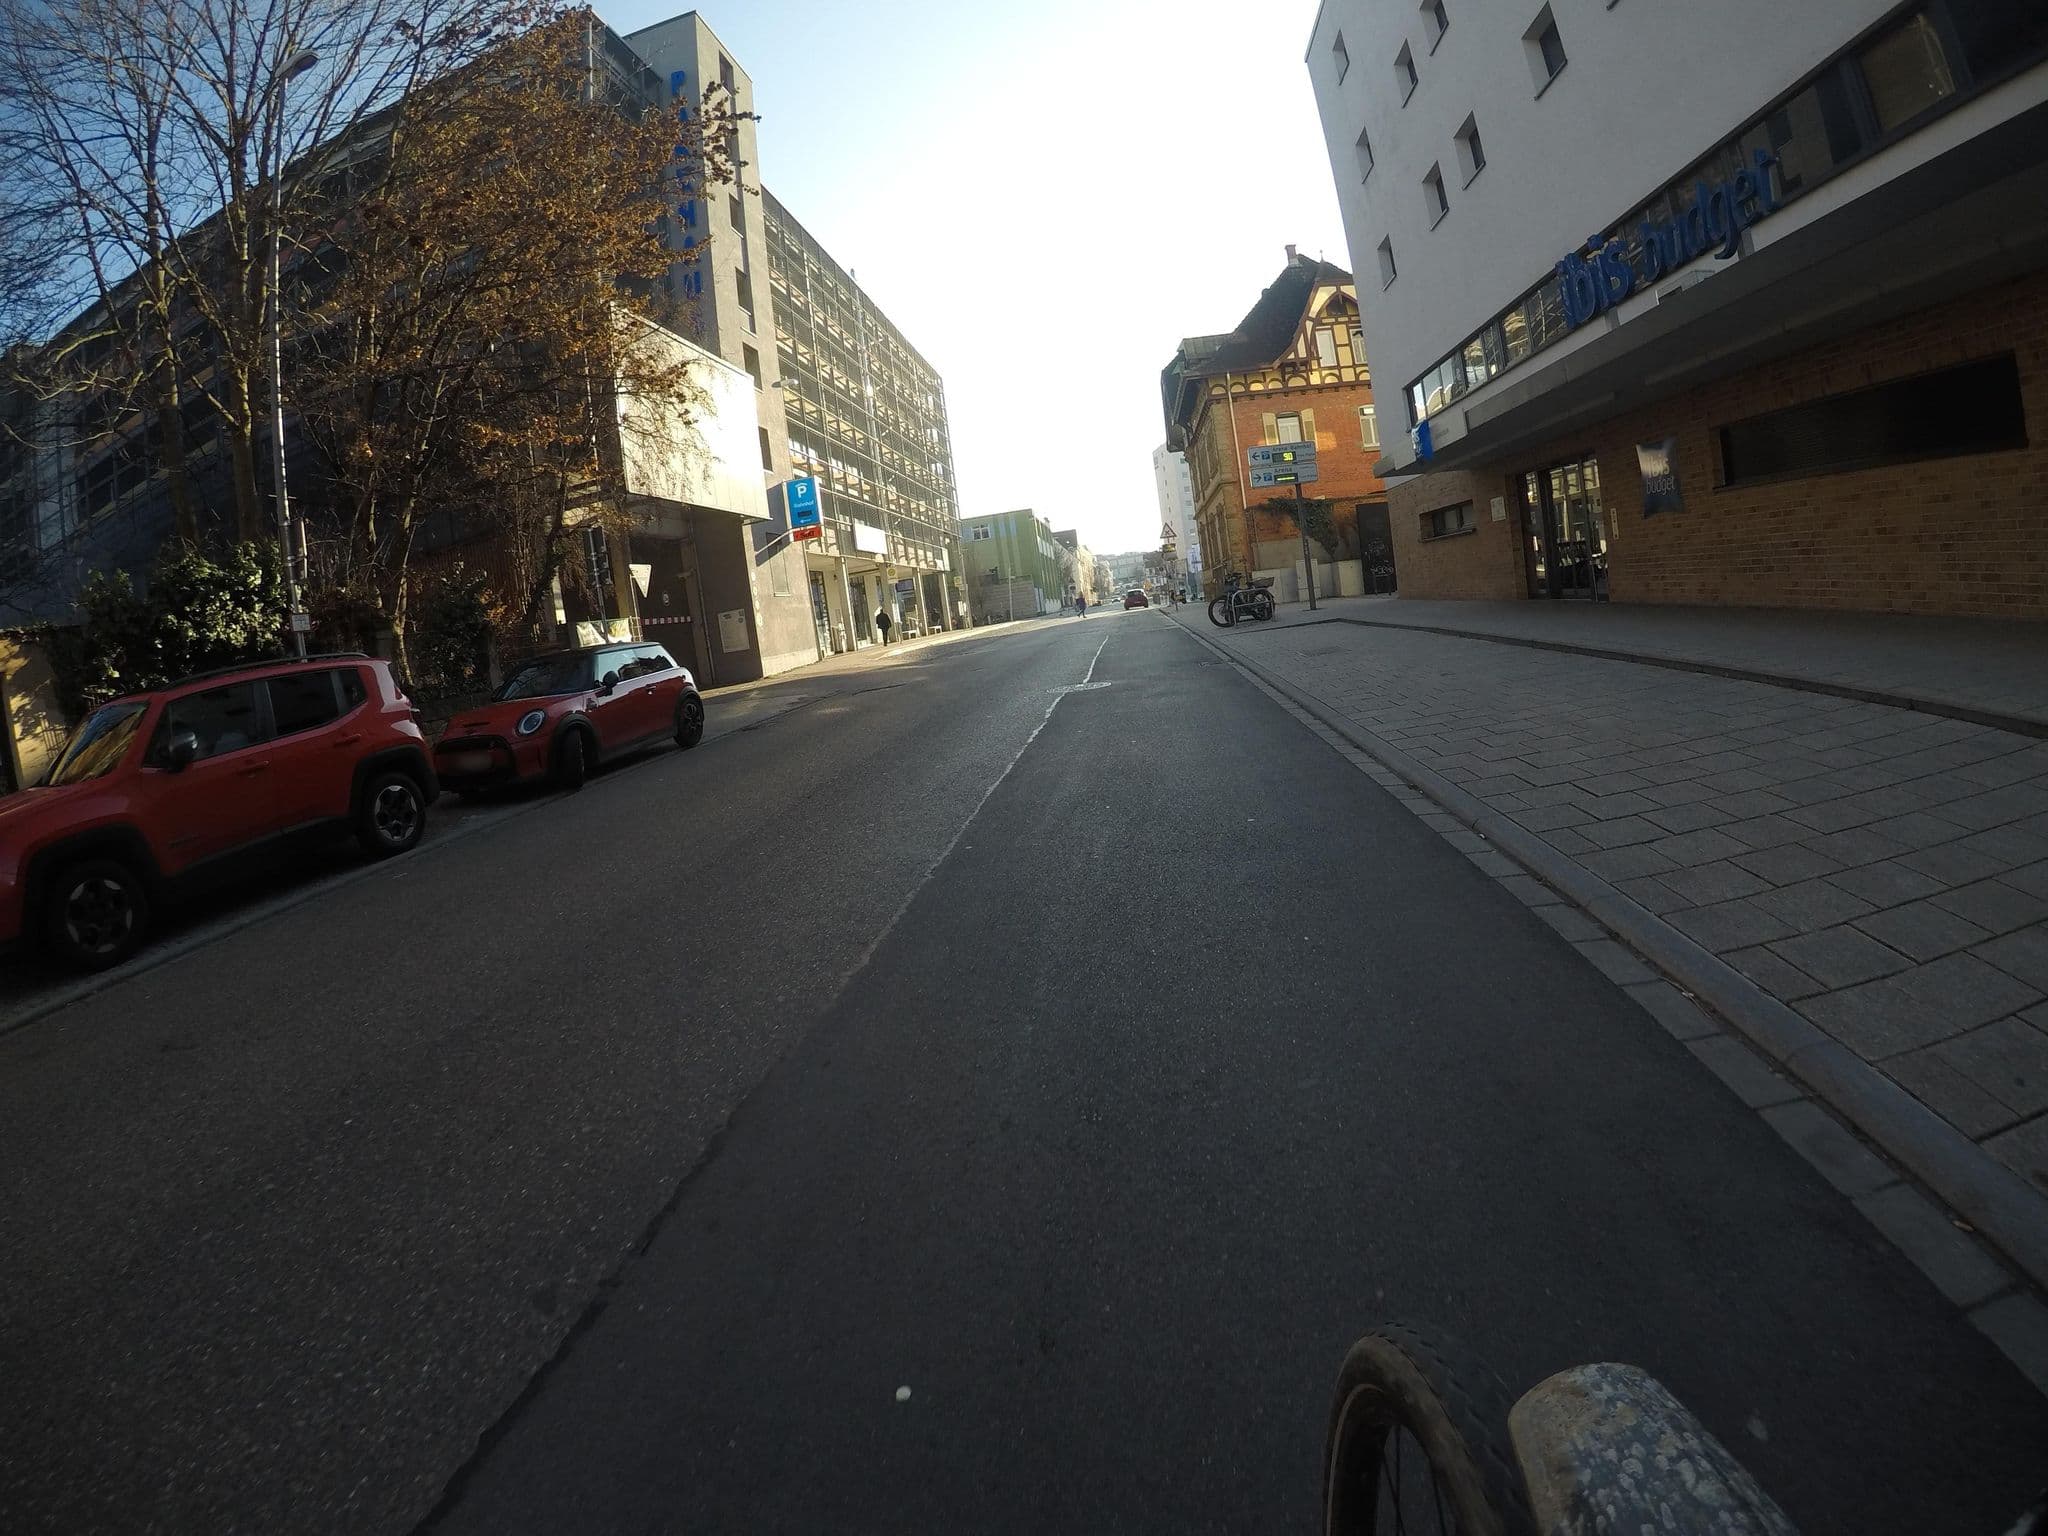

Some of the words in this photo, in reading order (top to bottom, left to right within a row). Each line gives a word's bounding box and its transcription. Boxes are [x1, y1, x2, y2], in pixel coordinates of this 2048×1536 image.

[1554, 233, 1636, 330] ibis
[1639, 150, 1785, 283] budget
[1648, 454, 1671, 478] ibis
[797, 486, 807, 498] P
[1646, 475, 1676, 496] budget
